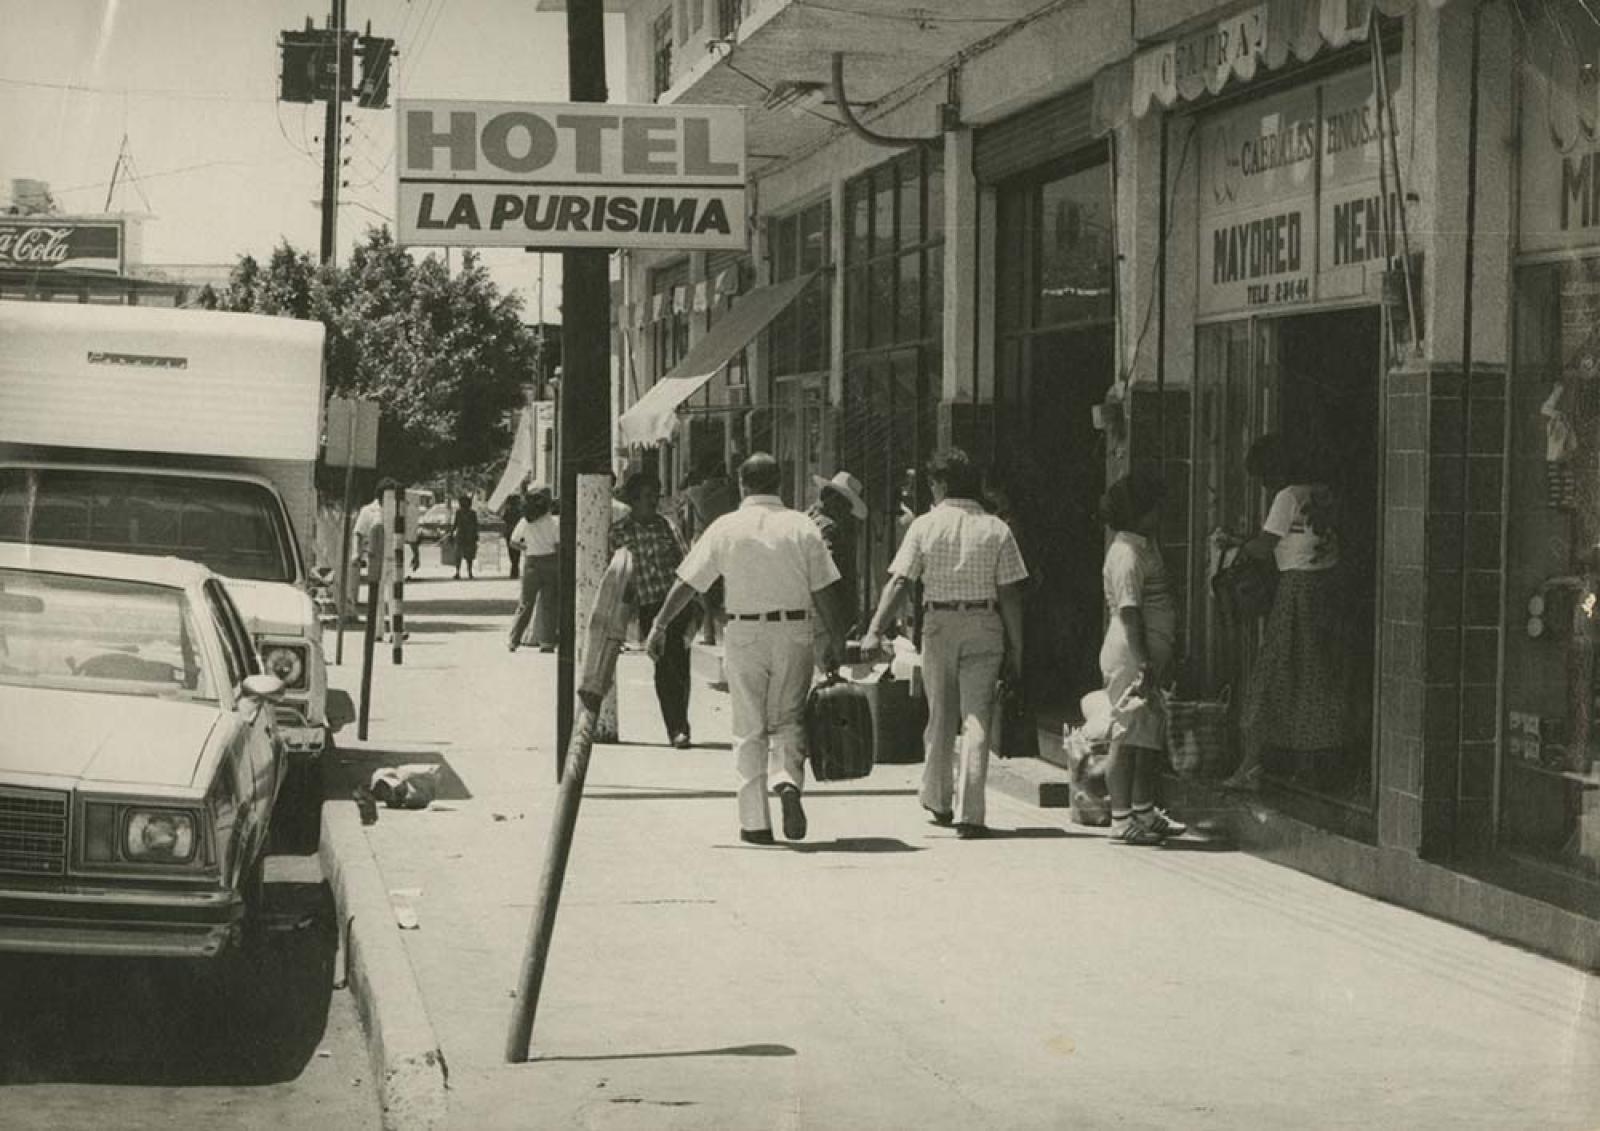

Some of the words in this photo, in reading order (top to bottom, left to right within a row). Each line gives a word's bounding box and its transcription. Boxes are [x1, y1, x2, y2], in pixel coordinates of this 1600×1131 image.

[407, 110, 739, 176] HOTEL
[416, 192, 481, 230] LA
[490, 194, 731, 234] PURISIMA
